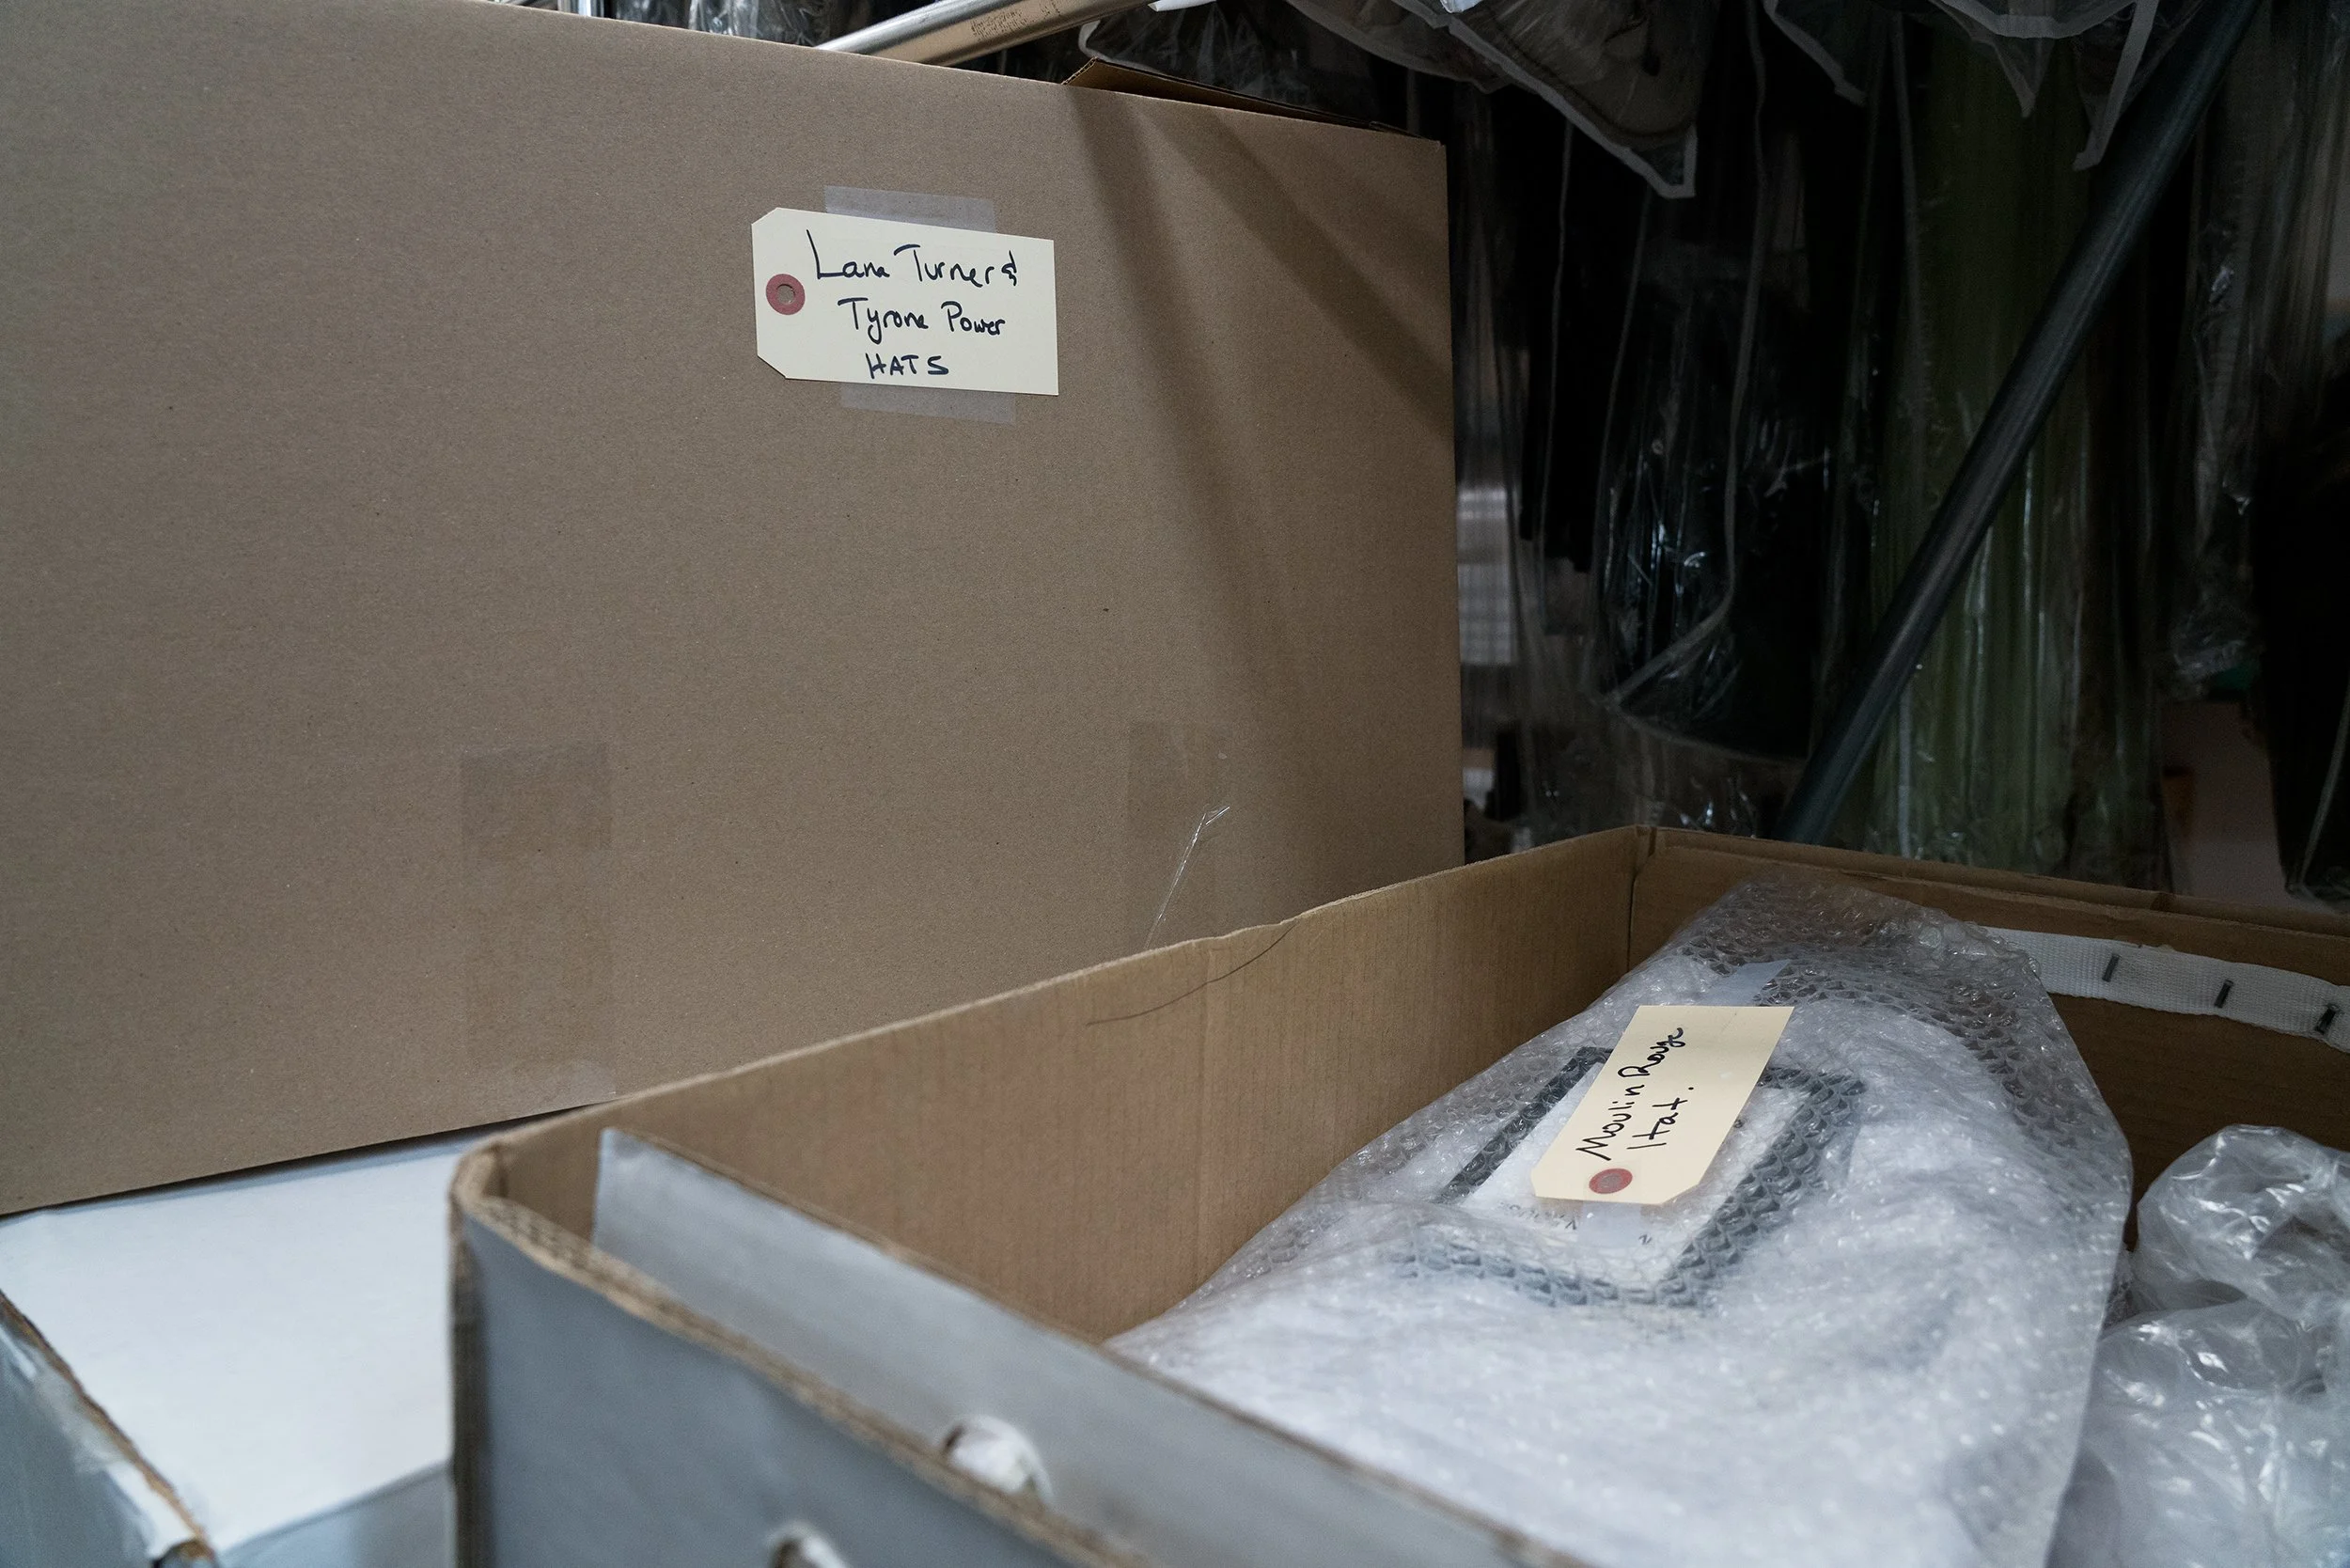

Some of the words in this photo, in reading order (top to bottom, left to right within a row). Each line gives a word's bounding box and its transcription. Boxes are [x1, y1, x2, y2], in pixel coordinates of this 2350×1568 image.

[806, 228, 891, 280] Lana
[893, 243, 995, 289] Turner
[837, 296, 930, 345] Tyrone
[940, 300, 1006, 337] Power
[865, 352, 949, 380] HATS
[1575, 1084, 1646, 1162] Moulin
[1617, 1027, 1686, 1078] Rouge
